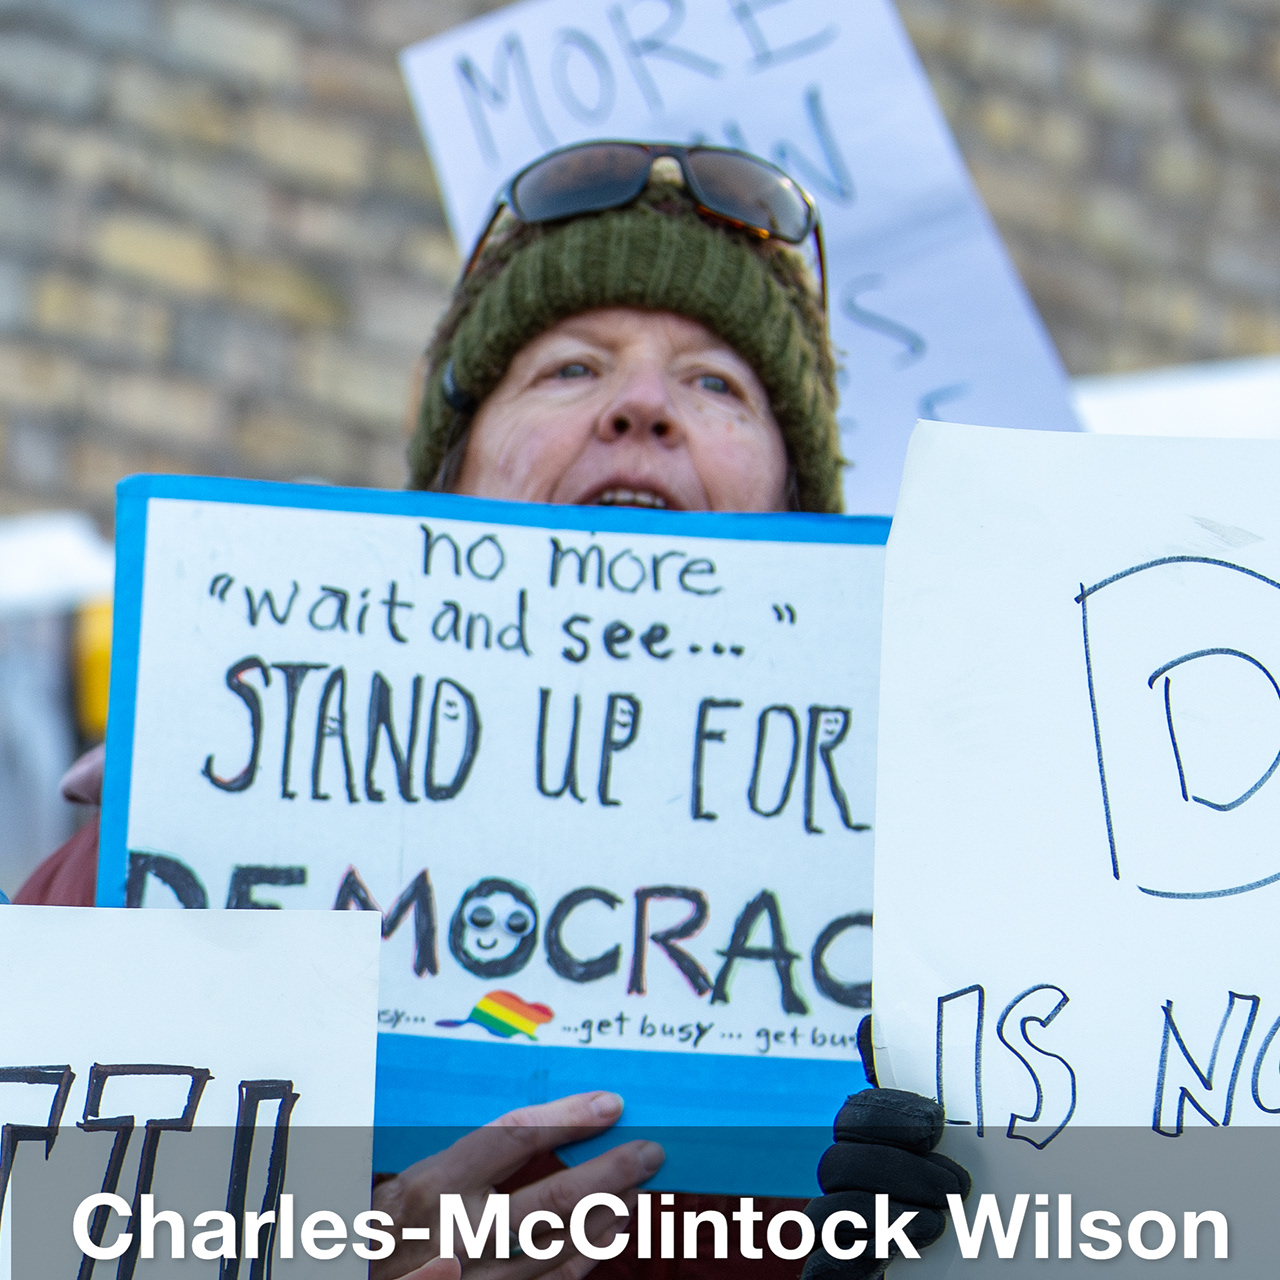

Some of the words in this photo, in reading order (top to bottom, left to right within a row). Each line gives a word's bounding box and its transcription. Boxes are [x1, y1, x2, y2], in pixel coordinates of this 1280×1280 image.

[421, 522, 506, 580] no
[549, 530, 725, 596] more
[432, 590, 531, 657] and
[201, 655, 482, 804] STAND
[536, 686, 641, 806] UP
[691, 697, 872, 835] FOR
[938, 984, 1077, 1151] IS
[1152, 990, 1280, 1138] N
